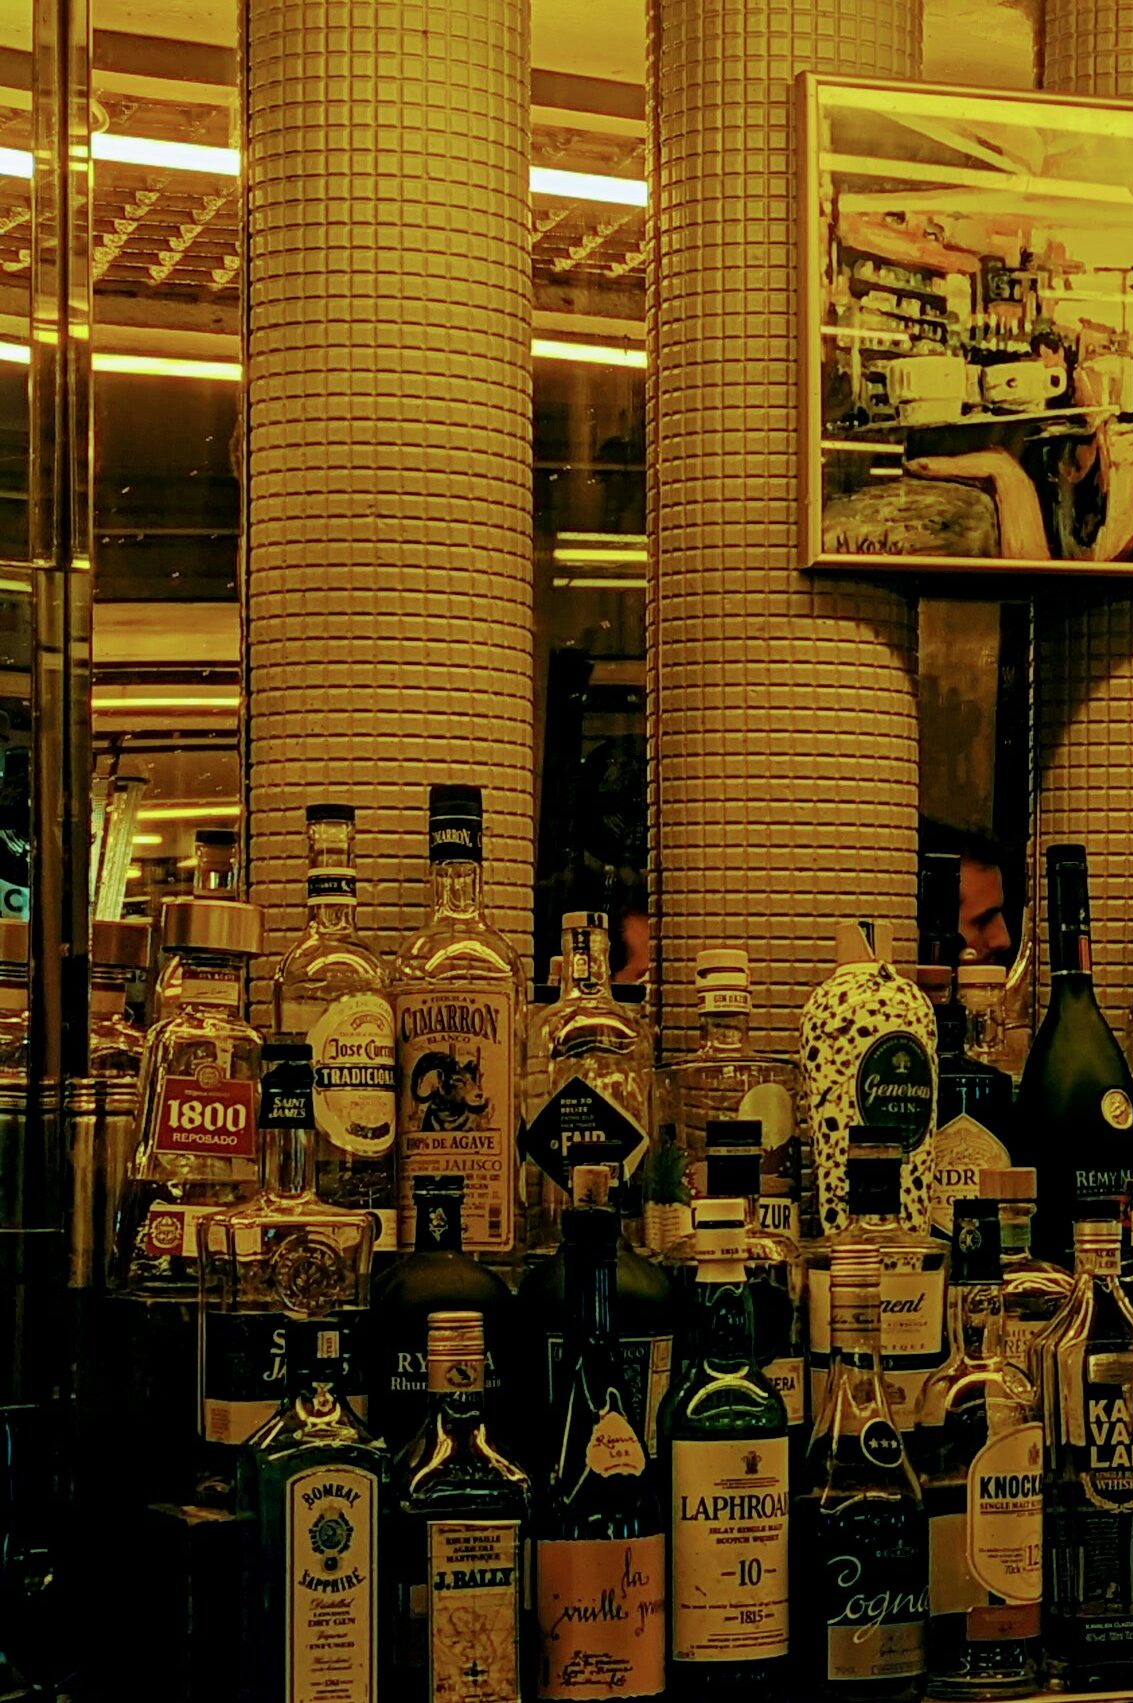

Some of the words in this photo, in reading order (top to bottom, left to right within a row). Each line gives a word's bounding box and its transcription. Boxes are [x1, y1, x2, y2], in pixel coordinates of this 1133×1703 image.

[401, 1003, 500, 1044] CIMARRON
[328, 1039, 363, 1060] Jose
[268, 1107, 306, 1119] JAMES
[273, 1096, 306, 1109] SAINT
[166, 1098, 247, 1133] 1800
[172, 1131, 238, 1146] REPOSADO
[432, 1138, 448, 1149] DE
[449, 1135, 495, 1150] AGAVE
[443, 1159, 504, 1172] JALISCO
[934, 1168, 977, 1187] NDR
[1088, 1399, 1131, 1423] KA
[1089, 1421, 1131, 1446] VA
[301, 1483, 362, 1511] BOMBAY
[680, 1491, 790, 1522] LAPHROAI
[298, 1566, 367, 1594] SAPPHIRE
[738, 1558, 762, 1587] 10
[308, 1619, 331, 1628] DRY
[333, 1617, 356, 1626] GIN
[739, 1609, 763, 1624] 1815
